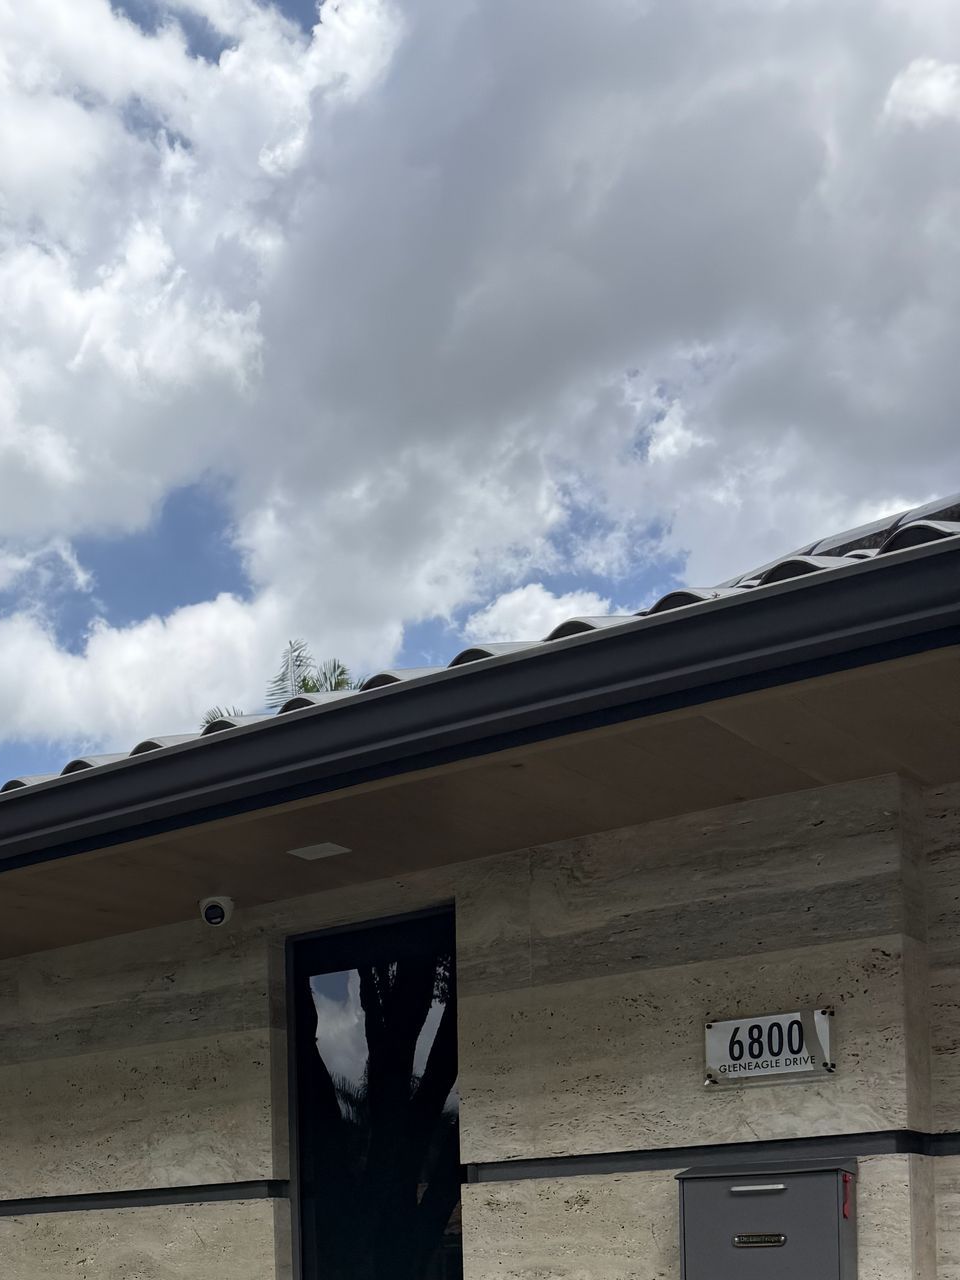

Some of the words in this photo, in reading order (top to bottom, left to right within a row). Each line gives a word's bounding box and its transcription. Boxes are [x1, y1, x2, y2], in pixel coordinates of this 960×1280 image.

[728, 1019, 804, 1061] 6800
[718, 1059, 781, 1074] GLENEAGLE
[784, 1055, 816, 1067] DRIVE
